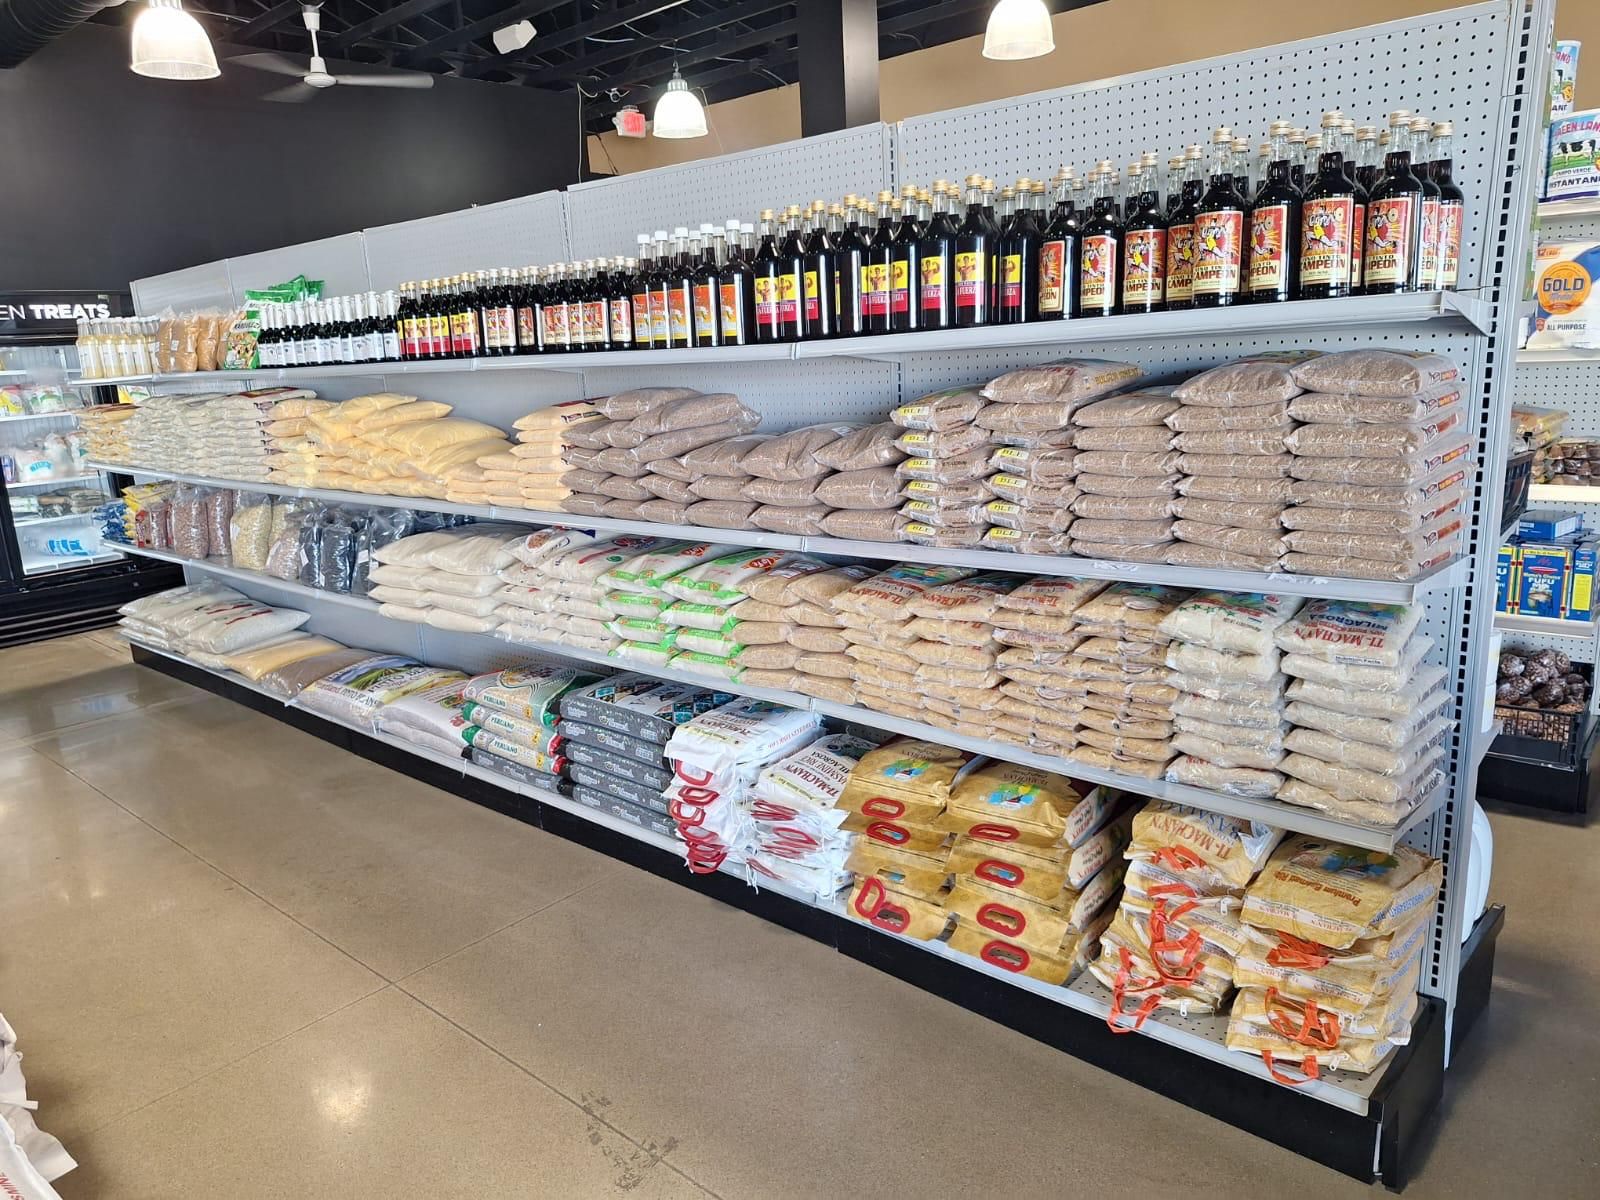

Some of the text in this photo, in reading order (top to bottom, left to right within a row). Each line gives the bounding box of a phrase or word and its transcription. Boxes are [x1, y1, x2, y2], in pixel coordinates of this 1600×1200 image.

[1543, 278, 1584, 292] GOLD
[28, 303, 111, 320] TREATS
[1547, 323, 1556, 331] ALL
